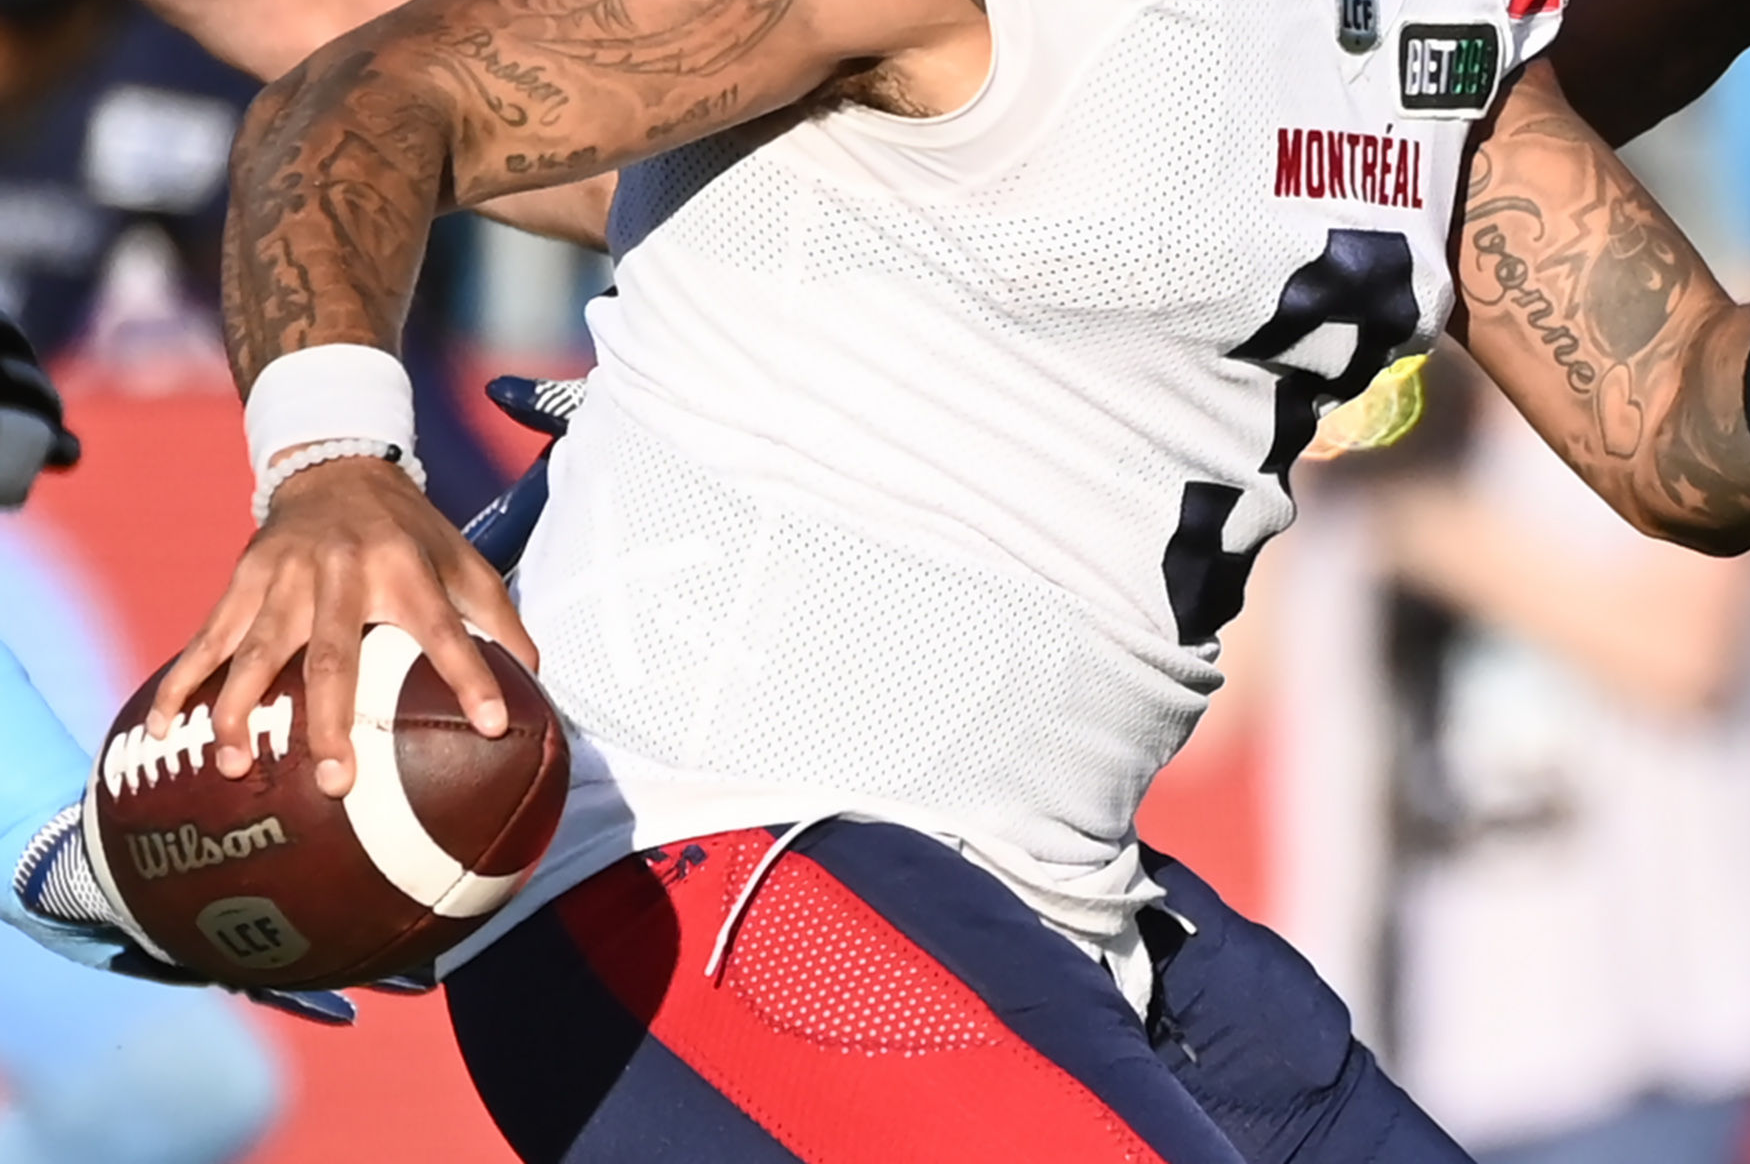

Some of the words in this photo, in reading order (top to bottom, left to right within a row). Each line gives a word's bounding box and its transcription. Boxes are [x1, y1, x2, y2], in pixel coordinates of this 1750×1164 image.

[1273, 123, 1424, 209] MONTRÉAL
[126, 815, 288, 880] Wilson
[216, 915, 283, 959] LCF
